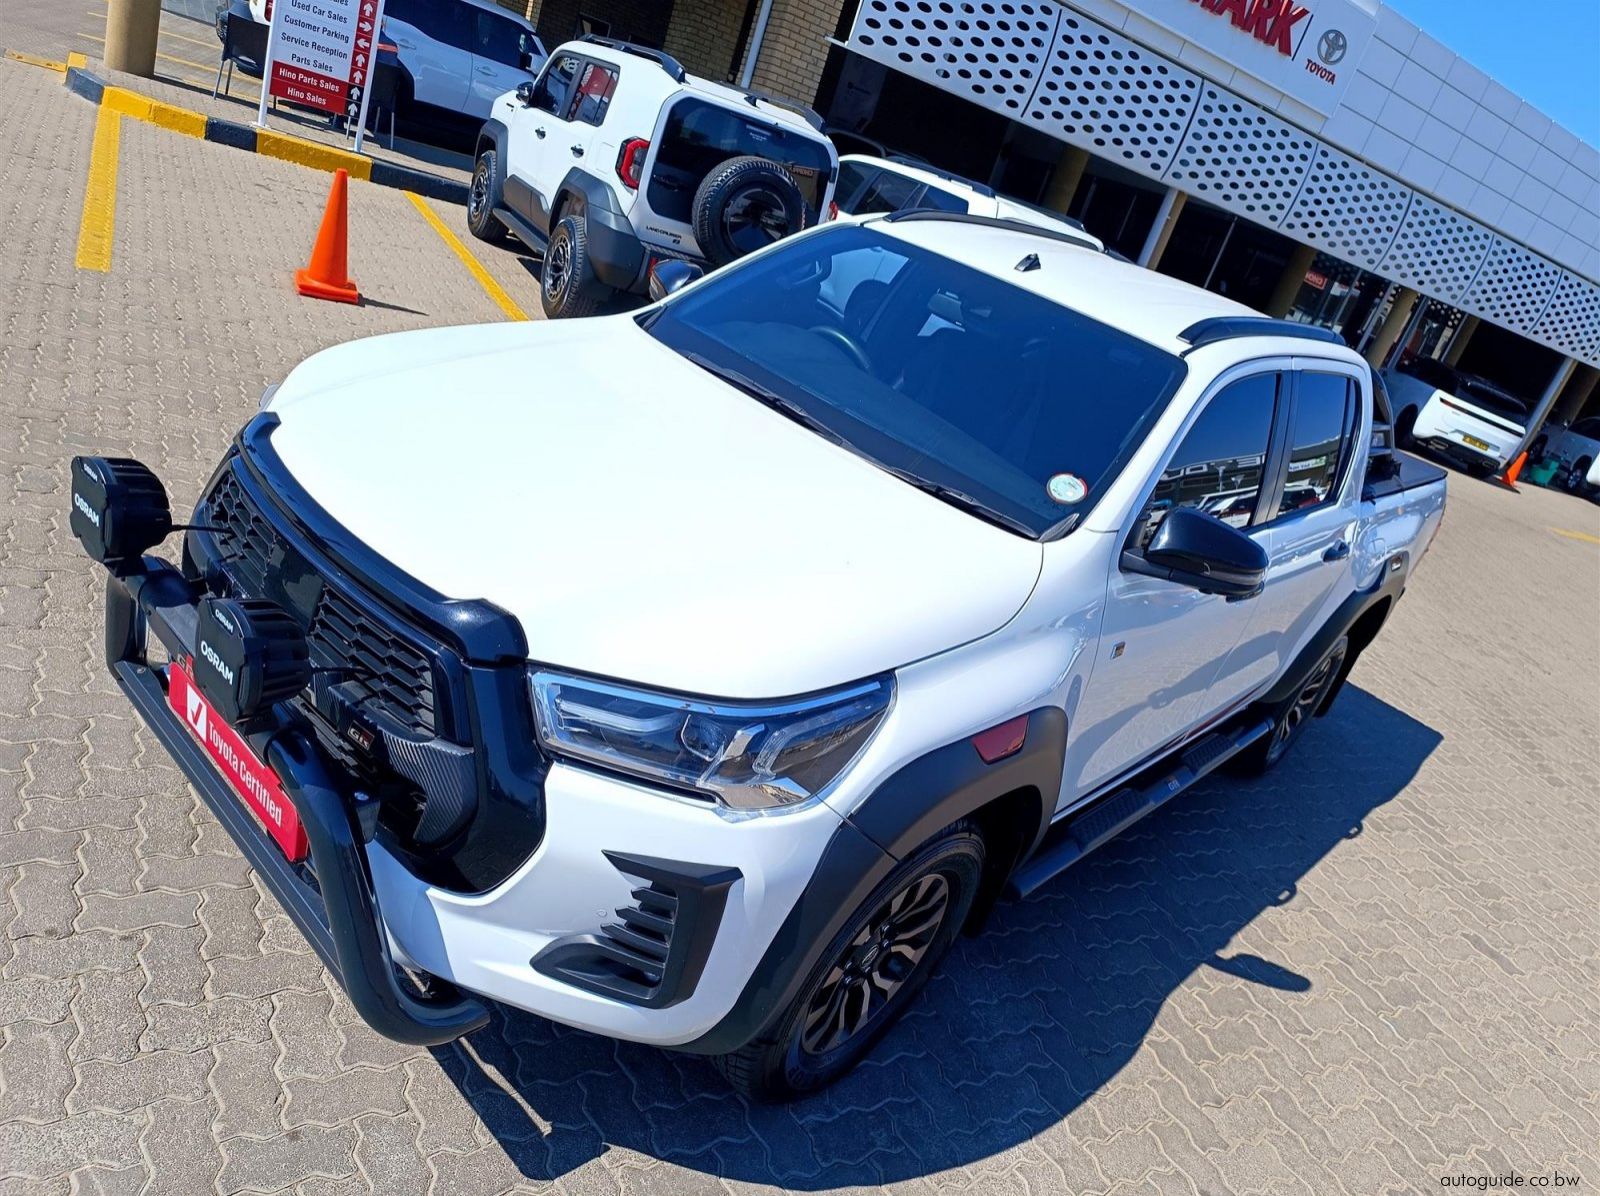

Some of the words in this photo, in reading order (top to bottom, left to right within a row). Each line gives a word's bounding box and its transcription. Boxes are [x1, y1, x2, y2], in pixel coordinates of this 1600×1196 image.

[291, 0, 310, 12] Used
[312, 6, 325, 17] Car
[327, 10, 348, 24] Sales
[284, 14, 320, 33] Customer
[322, 26, 349, 44] Parking
[1188, 0, 1310, 57] ARK
[281, 32, 309, 48] Service
[311, 41, 347, 59] Reception
[291, 53, 310, 66] Parts
[313, 59, 333, 72] Sales
[1305, 58, 1337, 86] TOYOTA
[279, 67, 296, 80] Hino
[298, 73, 317, 86] Parts
[319, 79, 340, 93] Sales
[287, 87, 305, 99] Hino
[306, 92, 327, 106] Sales
[74, 492, 100, 527] OSRAM
[215, 608, 234, 634] OSRAM
[200, 640, 234, 686] OSRAM
[208, 719, 239, 772] Toyota
[238, 762, 284, 829] Certified
